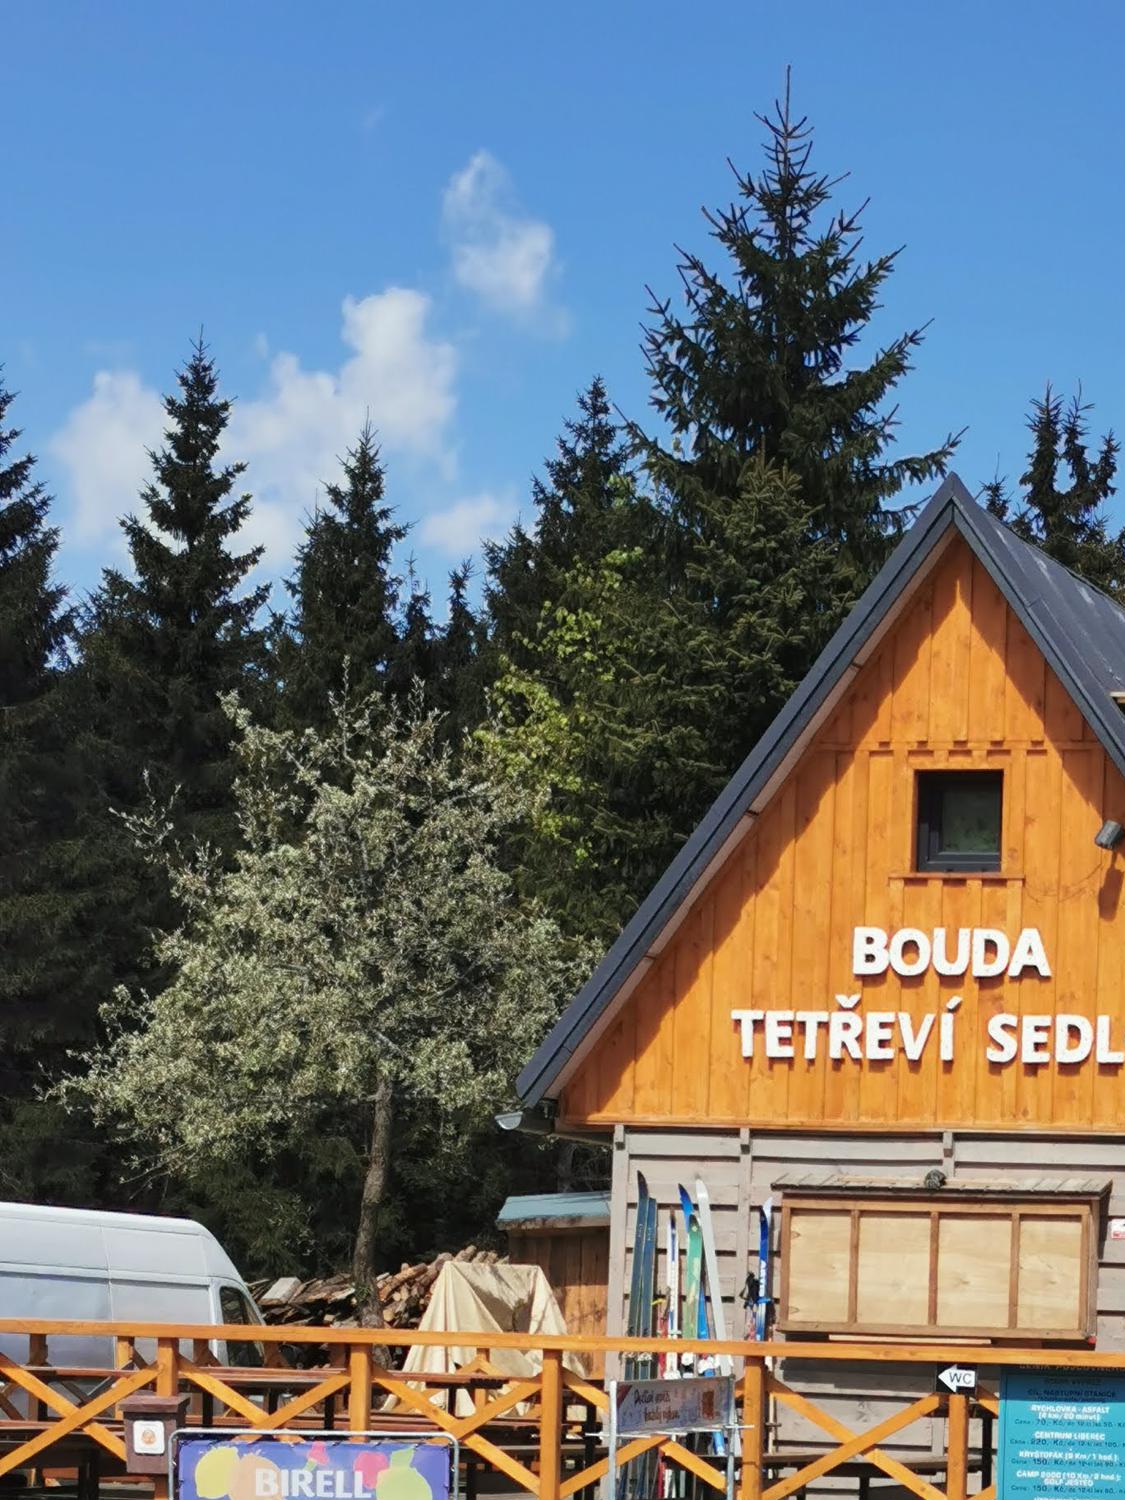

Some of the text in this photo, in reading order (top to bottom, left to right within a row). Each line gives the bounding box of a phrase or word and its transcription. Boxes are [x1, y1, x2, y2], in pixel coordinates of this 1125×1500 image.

[852, 926, 1051, 978] BOUDA
[730, 993, 963, 1062] TETŘEVÍ
[949, 1372, 972, 1385] WC
[256, 1469, 373, 1499] BIRELL
